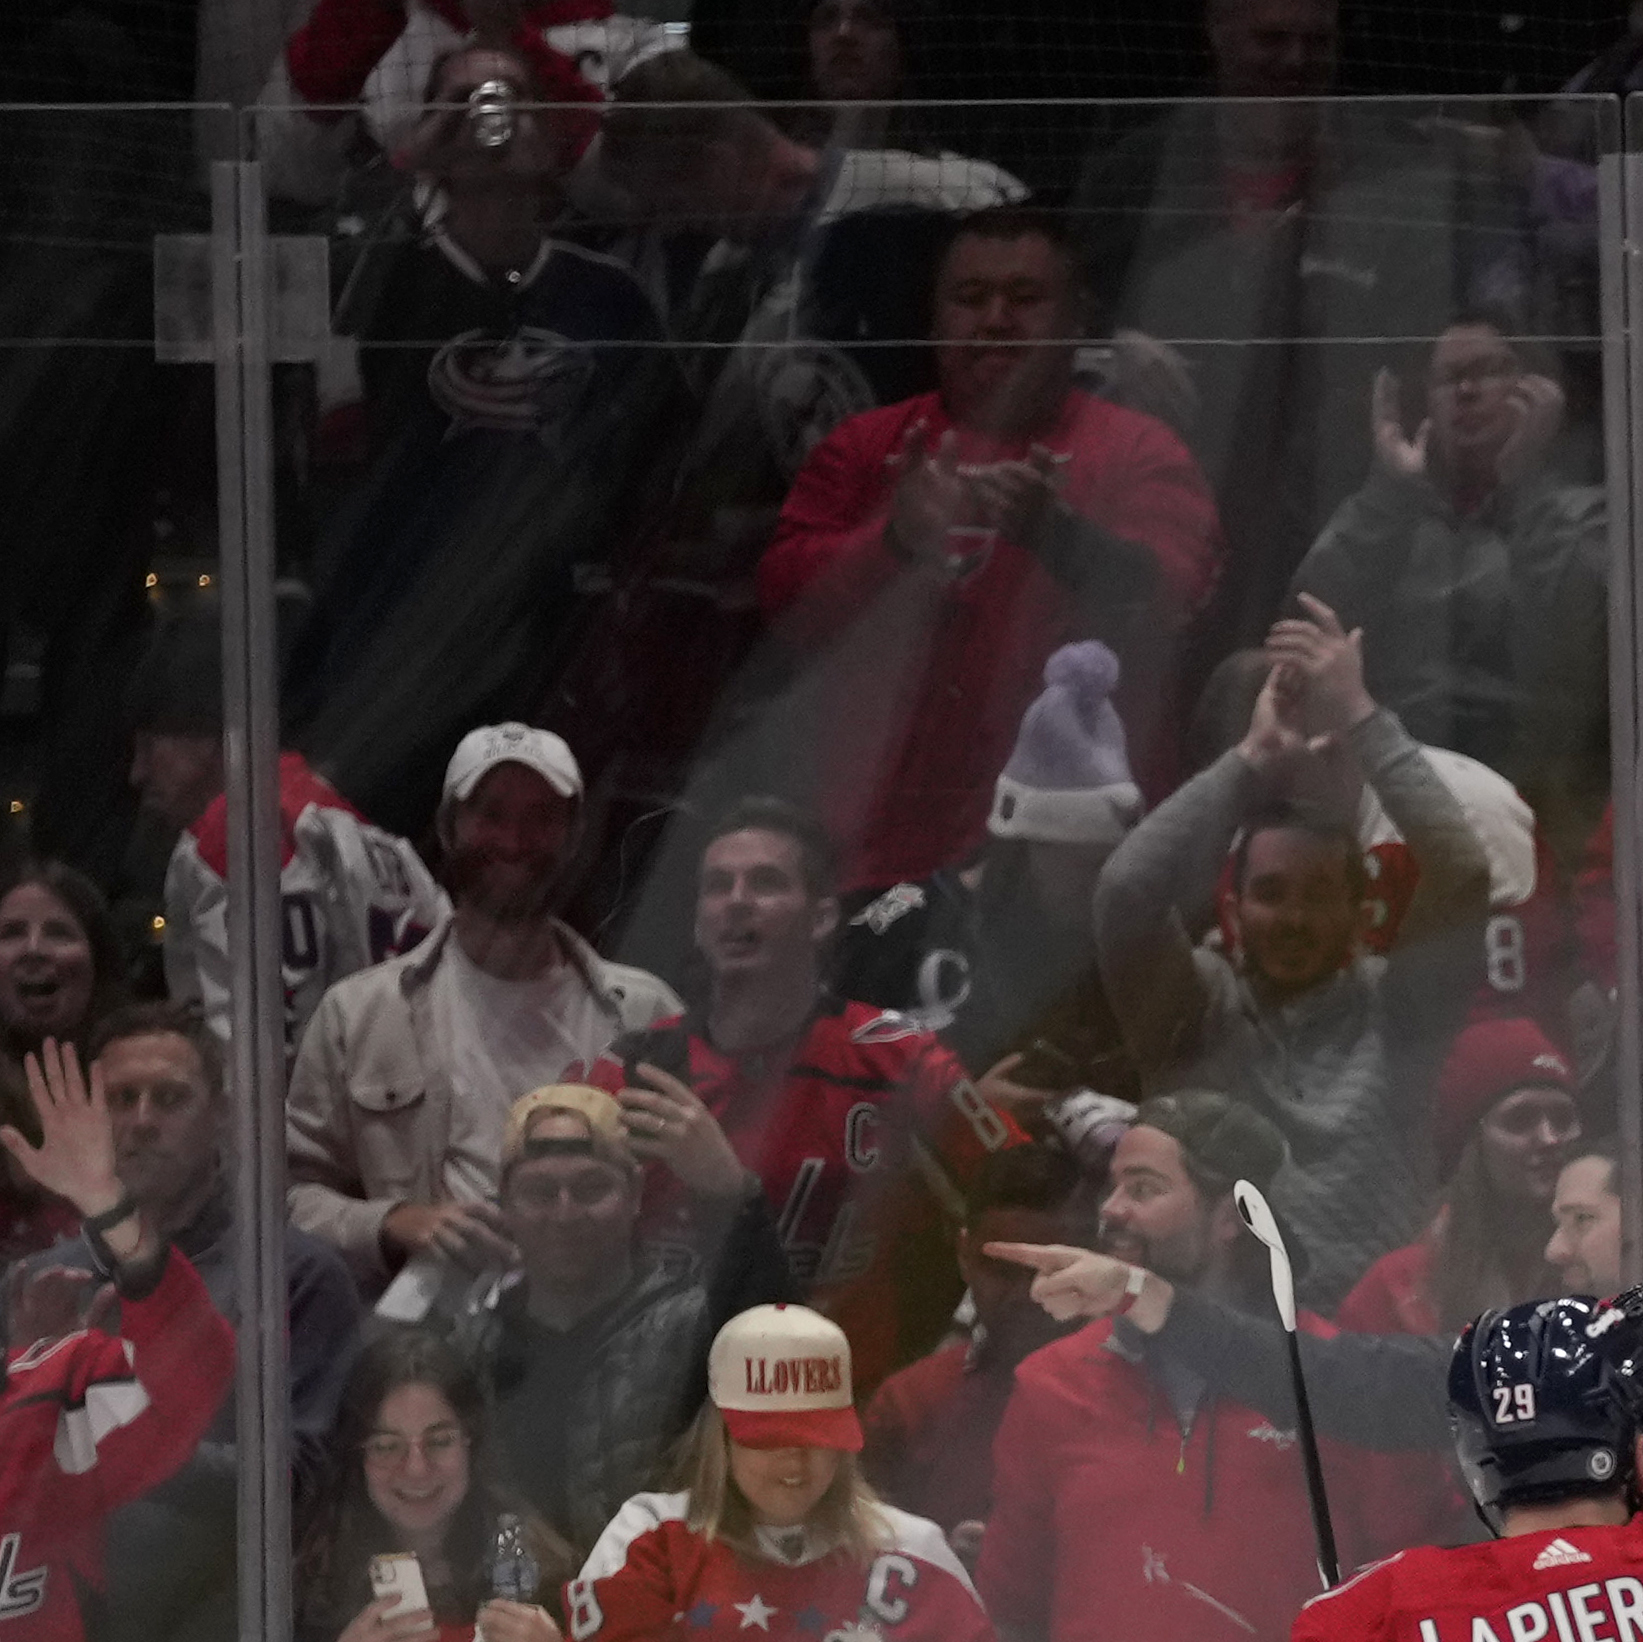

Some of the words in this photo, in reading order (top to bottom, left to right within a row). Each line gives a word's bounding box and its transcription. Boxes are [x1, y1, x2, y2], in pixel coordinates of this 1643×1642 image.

[744, 1355, 841, 1395] LLOVERS
[1492, 1382, 1537, 1425] 29
[567, 1578, 604, 1642] 8
[867, 1553, 918, 1626] C
